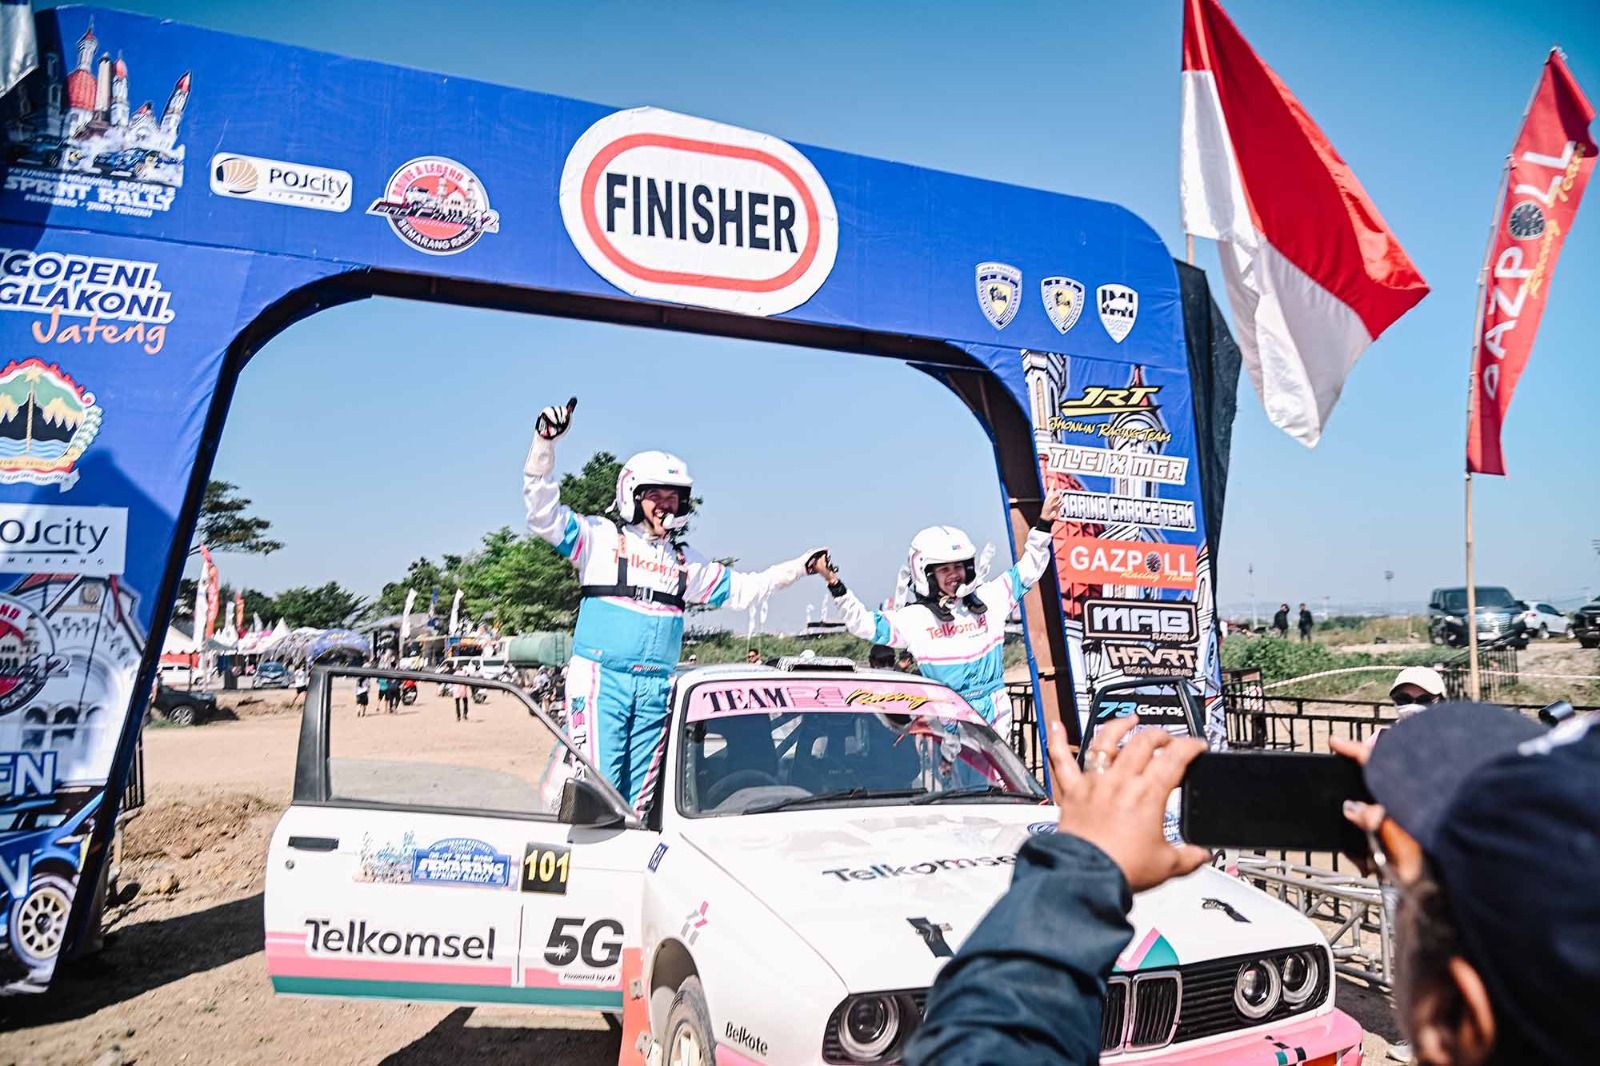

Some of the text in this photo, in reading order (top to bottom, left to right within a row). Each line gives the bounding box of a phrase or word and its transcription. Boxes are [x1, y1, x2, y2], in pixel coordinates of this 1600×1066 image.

[4, 175, 176, 211] SPRINT RALLY
[269, 167, 349, 199] POJcity
[606, 172, 798, 253] FINISHER
[397, 218, 450, 250] SEMARANG
[0, 252, 158, 290] GOPENI.
[32, 306, 166, 355] Jateng
[1061, 387, 1160, 407] JRT
[1097, 422, 1140, 439] RACING
[1139, 428, 1172, 443] TEAM
[1107, 452, 1128, 475] X
[1130, 456, 1185, 481] MGR
[1108, 497, 1160, 525] GARAGE
[1160, 501, 1195, 529] TEAM
[1152, 633, 1190, 641] RACING
[703, 687, 787, 713] TEAM
[1097, 702, 1137, 718] 73
[416, 858, 504, 876] SEMARANG
[462, 872, 491, 884] RALLY
[524, 849, 570, 883] 101
[305, 919, 496, 960] Telkomsel
[544, 917, 625, 968] 5G
[596, 974, 606, 983] by
[725, 1021, 768, 1056] Belkote
